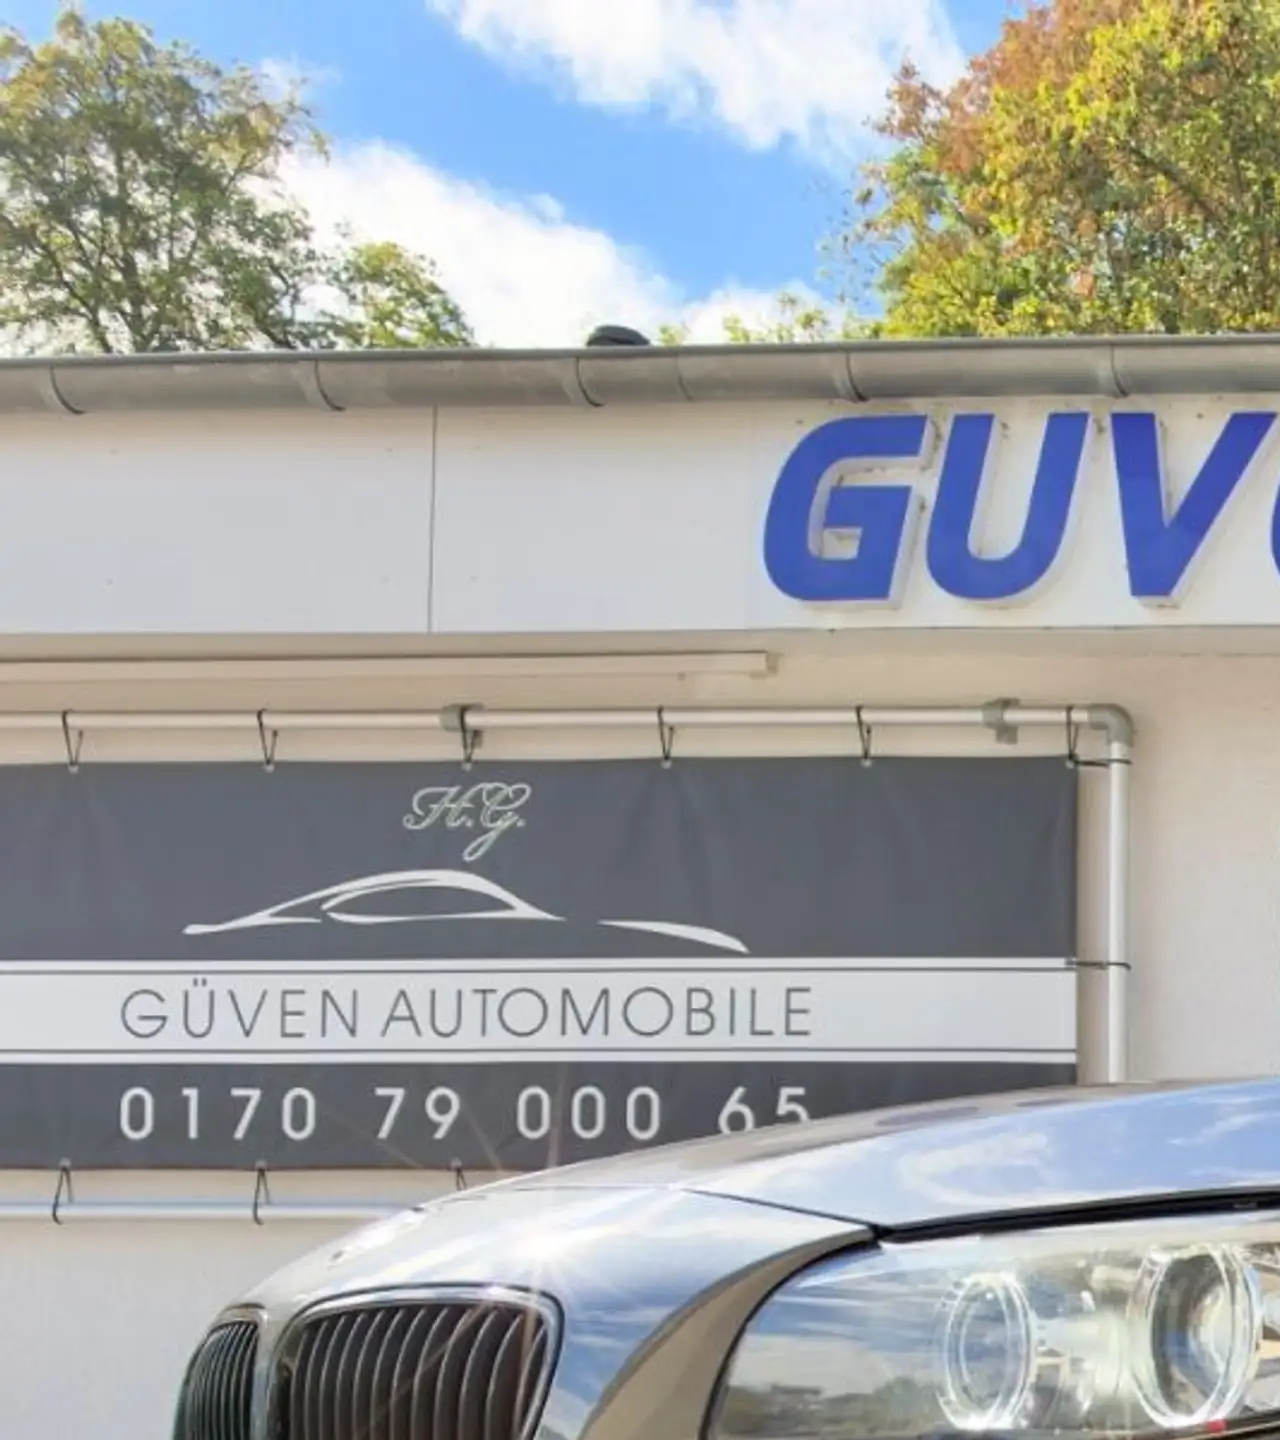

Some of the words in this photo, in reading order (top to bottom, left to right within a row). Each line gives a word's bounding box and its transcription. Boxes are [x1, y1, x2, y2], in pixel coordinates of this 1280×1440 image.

[120, 977, 359, 1039] GÜVEN
[380, 986, 812, 1038] AUTOMOBILE
[119, 1086, 316, 1141] 0170
[373, 1086, 460, 1140] 79
[516, 1085, 661, 1140] 000
[717, 1086, 810, 1134] 65
